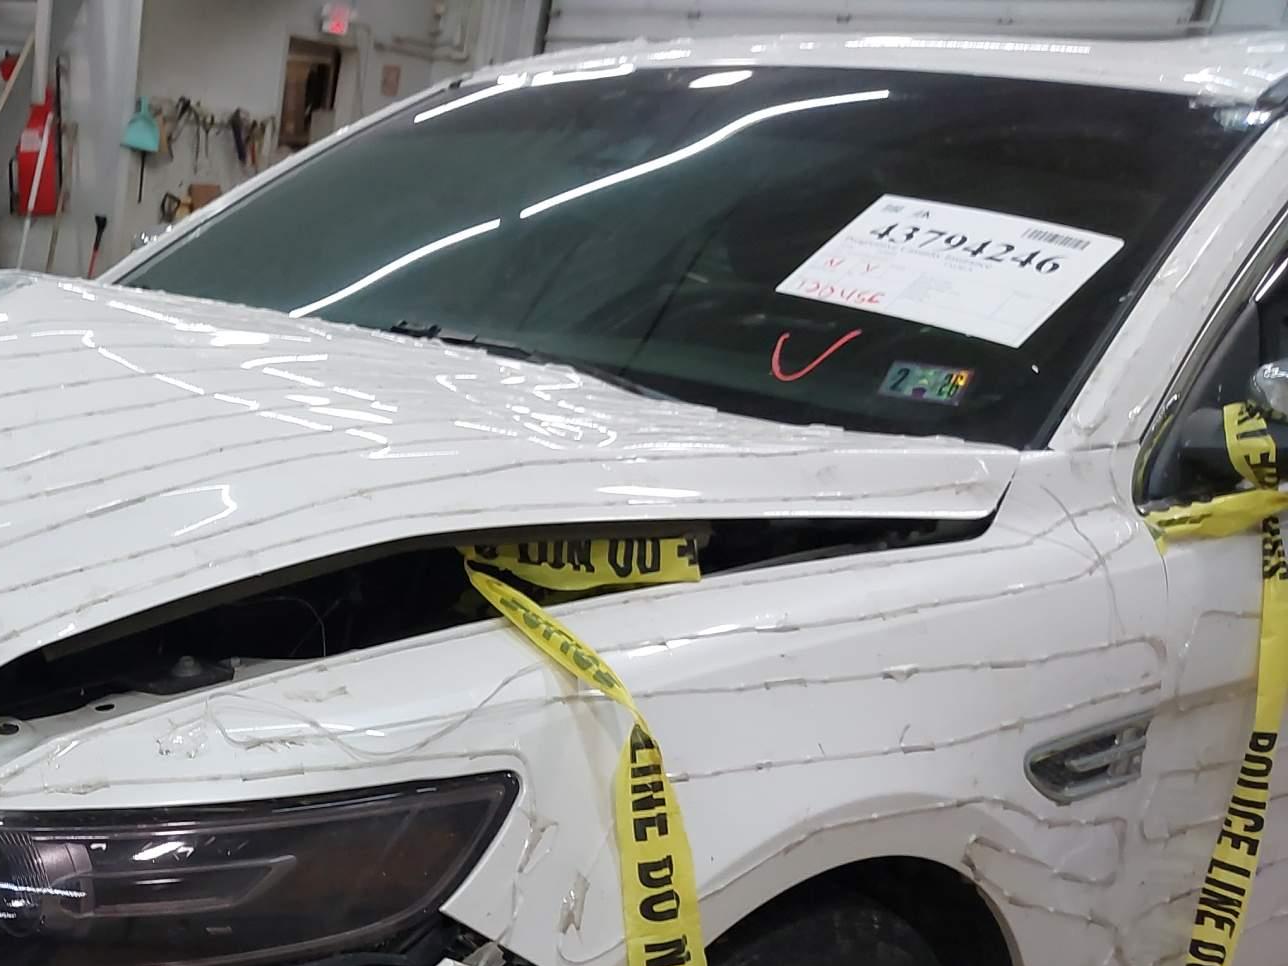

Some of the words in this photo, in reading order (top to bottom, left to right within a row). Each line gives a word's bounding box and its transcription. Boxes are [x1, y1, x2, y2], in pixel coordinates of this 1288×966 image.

[870, 222, 1062, 275] 43794246
[890, 367, 910, 391] 2
[630, 734, 669, 842] LINE
[1217, 731, 1277, 857] POLICE
[637, 855, 680, 922] DO
[1195, 858, 1251, 939] LINE
